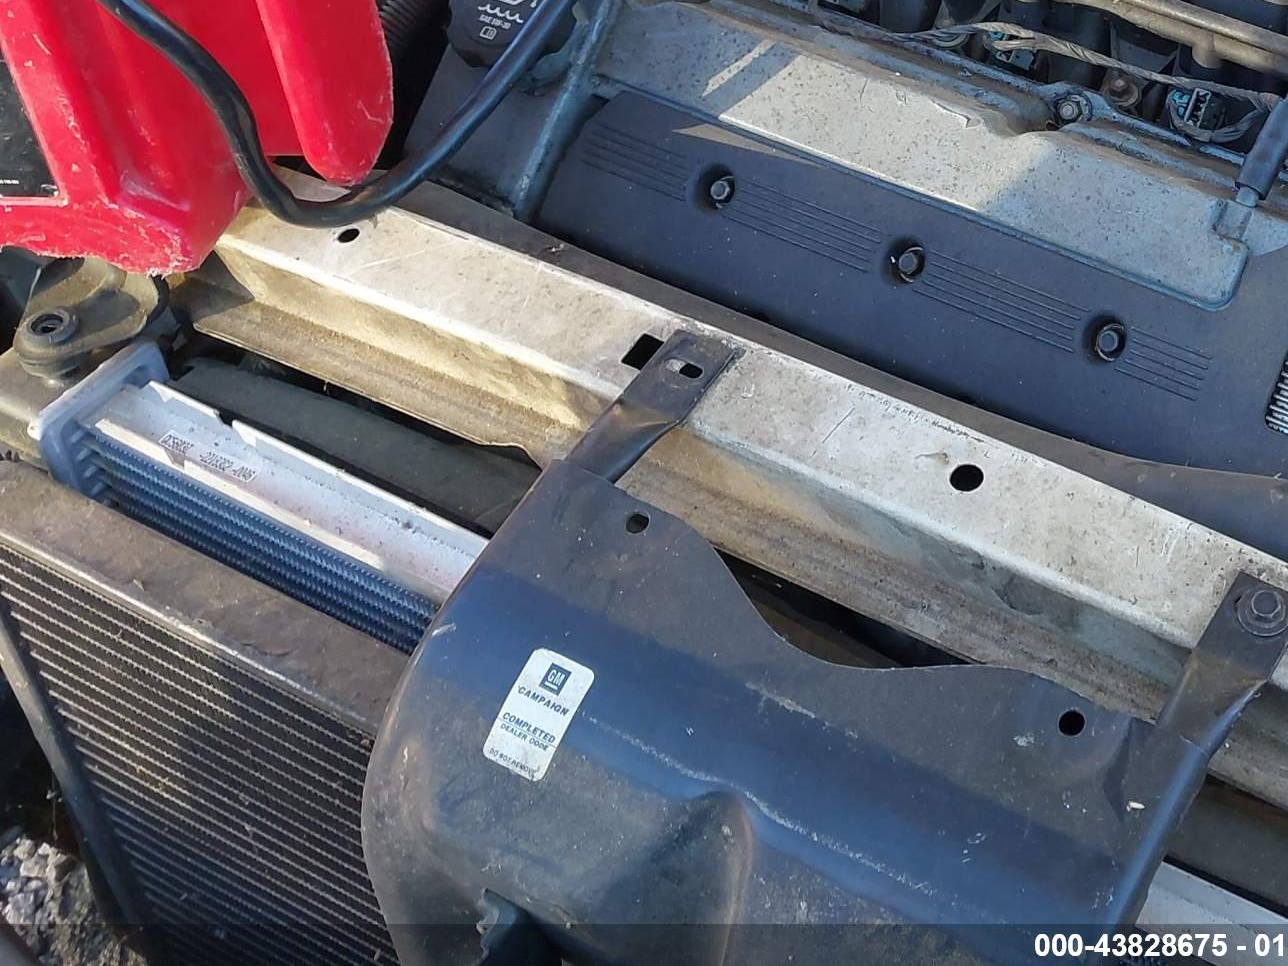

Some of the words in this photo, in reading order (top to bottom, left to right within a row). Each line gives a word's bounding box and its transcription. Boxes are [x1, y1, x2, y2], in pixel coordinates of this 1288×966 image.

[548, 669, 566, 686] GM
[517, 686, 570, 717] CAMPAIGN
[500, 723, 527, 741] DEALER
[502, 712, 557, 744] COMPLETED
